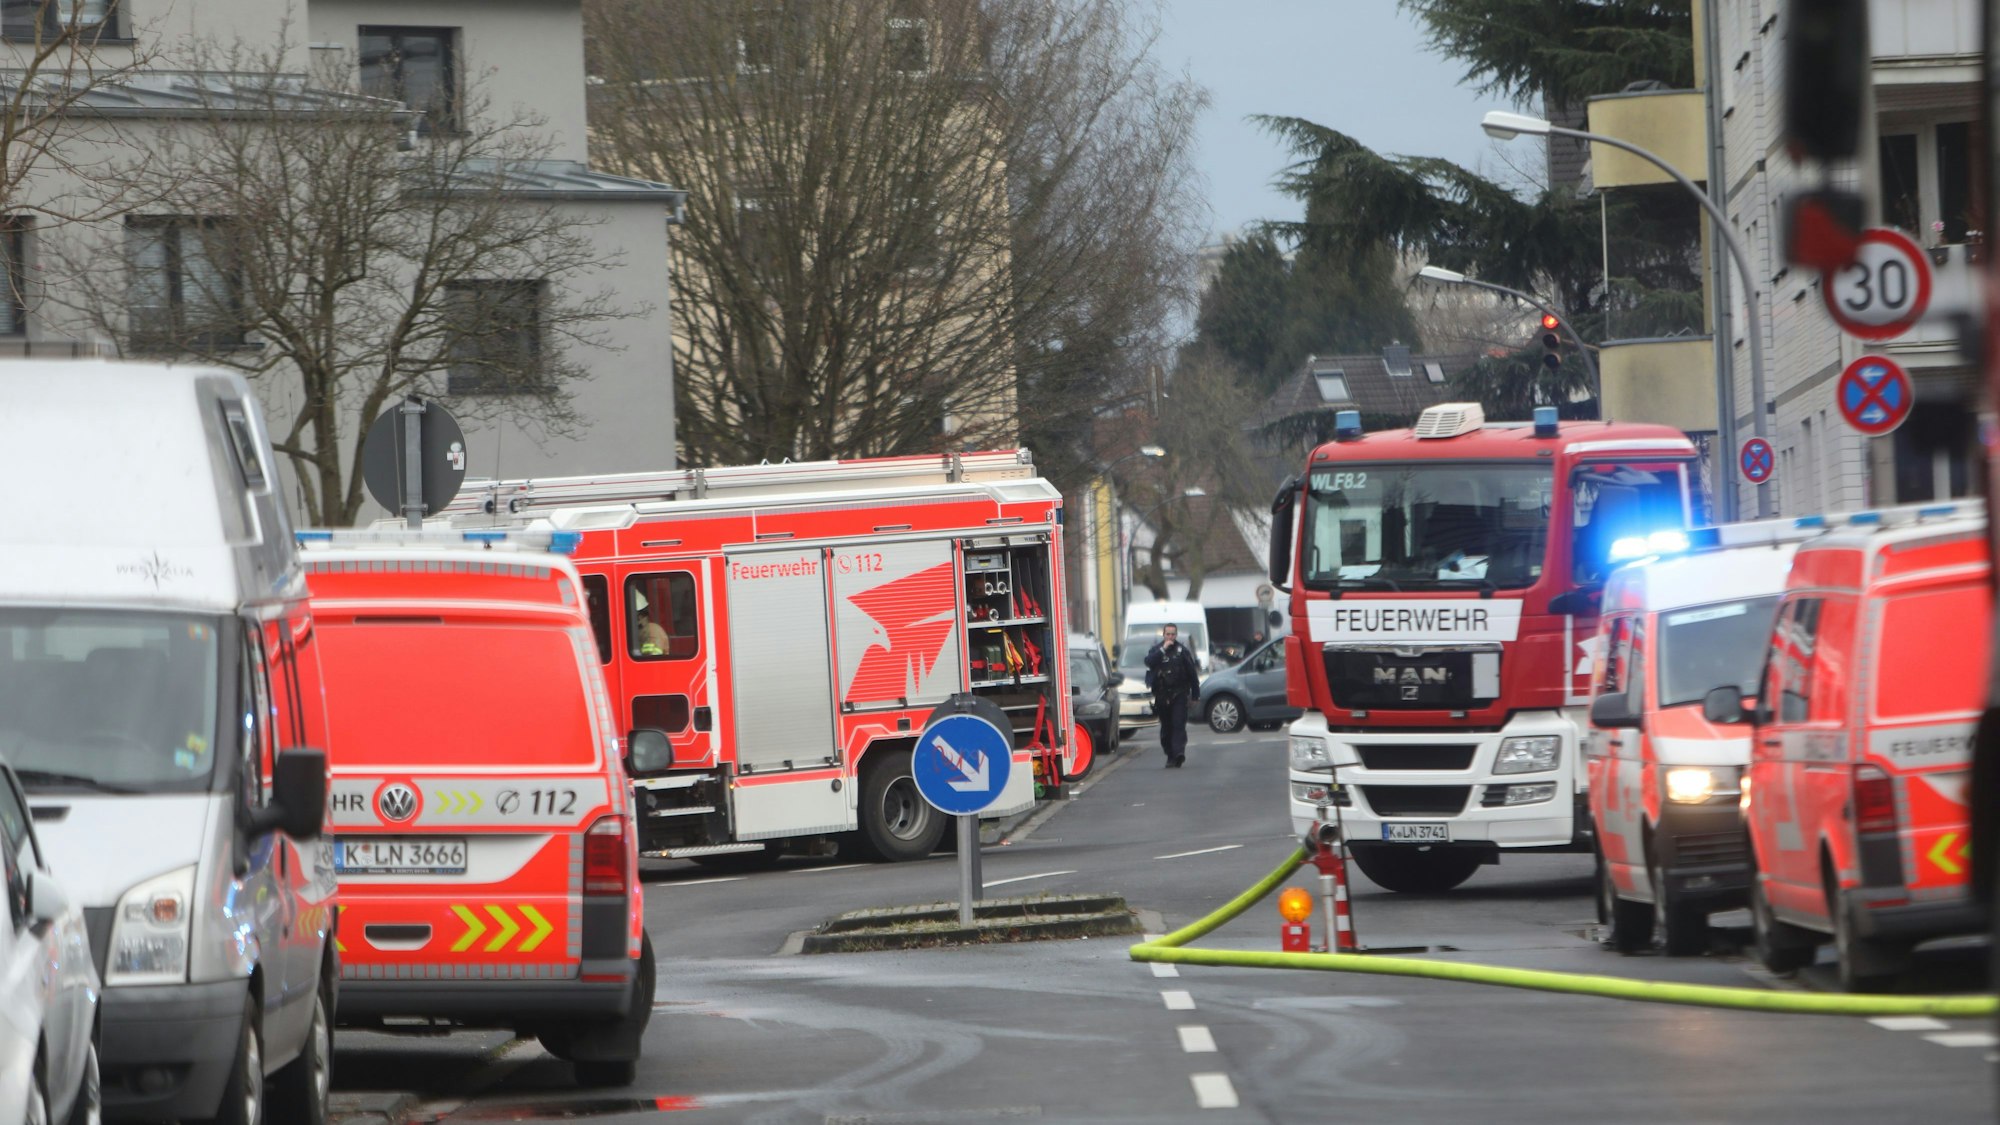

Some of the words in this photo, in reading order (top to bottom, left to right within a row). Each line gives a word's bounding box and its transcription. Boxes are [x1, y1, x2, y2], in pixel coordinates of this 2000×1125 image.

[1843, 259, 1908, 312] 30
[1311, 472, 1367, 491] WLF8.2
[731, 557, 818, 581] Feuerwehr
[855, 553, 883, 573] 112
[1335, 608, 1489, 632] FEUERWEHR
[1373, 667, 1447, 685] MAN
[332, 794, 365, 812] HR
[530, 789, 578, 816] 112
[1389, 826, 1396, 838] K
[1403, 826, 1417, 838] LN
[1419, 826, 1446, 838] 3741
[345, 845, 359, 865] K
[375, 845, 404, 865] LN
[409, 844, 463, 865] 3666
